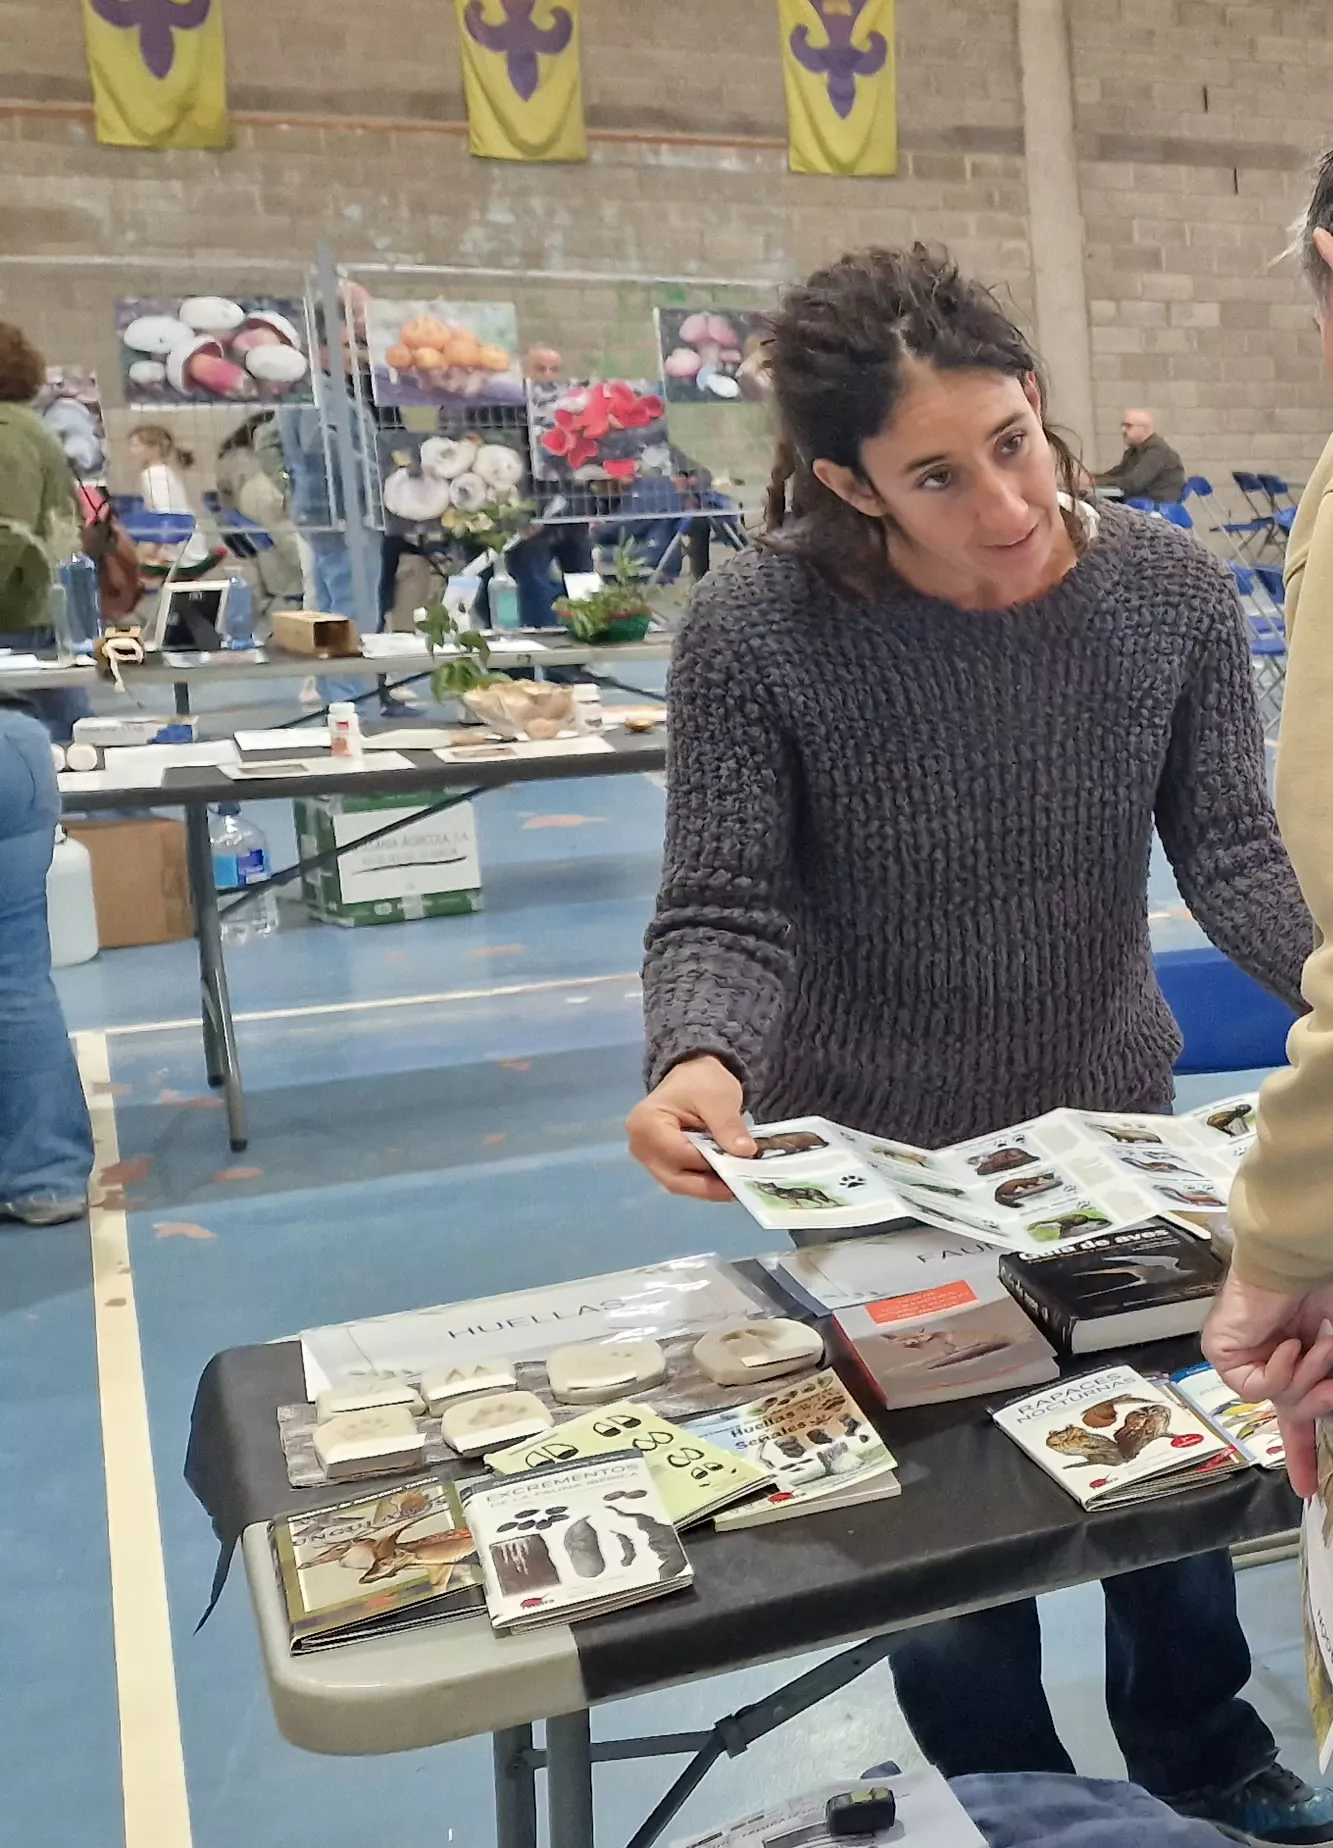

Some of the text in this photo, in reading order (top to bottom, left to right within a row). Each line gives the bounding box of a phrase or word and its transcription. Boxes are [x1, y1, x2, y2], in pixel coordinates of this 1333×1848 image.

[1079, 1239, 1110, 1251] de
[1114, 1228, 1170, 1246] aves
[448, 1298, 626, 1339] HUELLAS
[1016, 1376, 1137, 1424] NOCTURNAS
[1018, 1373, 1122, 1415] RAPACES
[731, 1410, 796, 1438] Huellas
[735, 1421, 806, 1450] Señales
[487, 1463, 640, 1503] EXCREMENTOS
